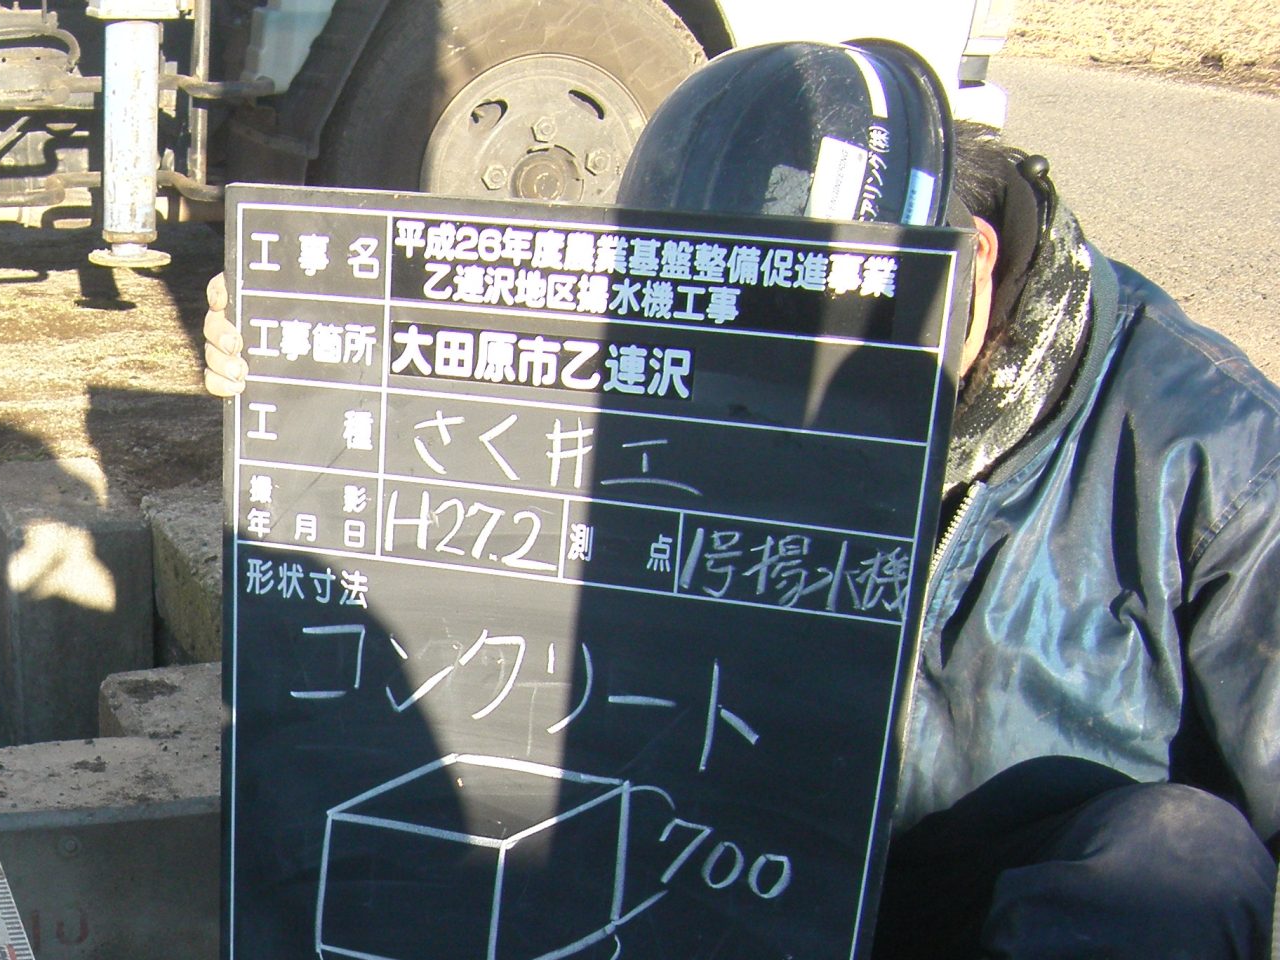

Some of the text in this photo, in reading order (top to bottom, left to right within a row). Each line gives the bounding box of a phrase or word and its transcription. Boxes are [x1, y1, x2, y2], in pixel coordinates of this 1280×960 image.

[248, 231, 381, 281] 工事名
[394, 219, 898, 298] 平成26年度農業基盤整備促進事業
[423, 262, 740, 325] 乙連沢地区揚水機工事
[248, 317, 375, 367] 工事箇所
[390, 325, 691, 400] 大田原市乙連沢
[384, 489, 559, 573] H27.2
[246, 558, 369, 609] 形状寸法
[289, 623, 760, 772] コンクリート
[658, 817, 792, 900] 700
